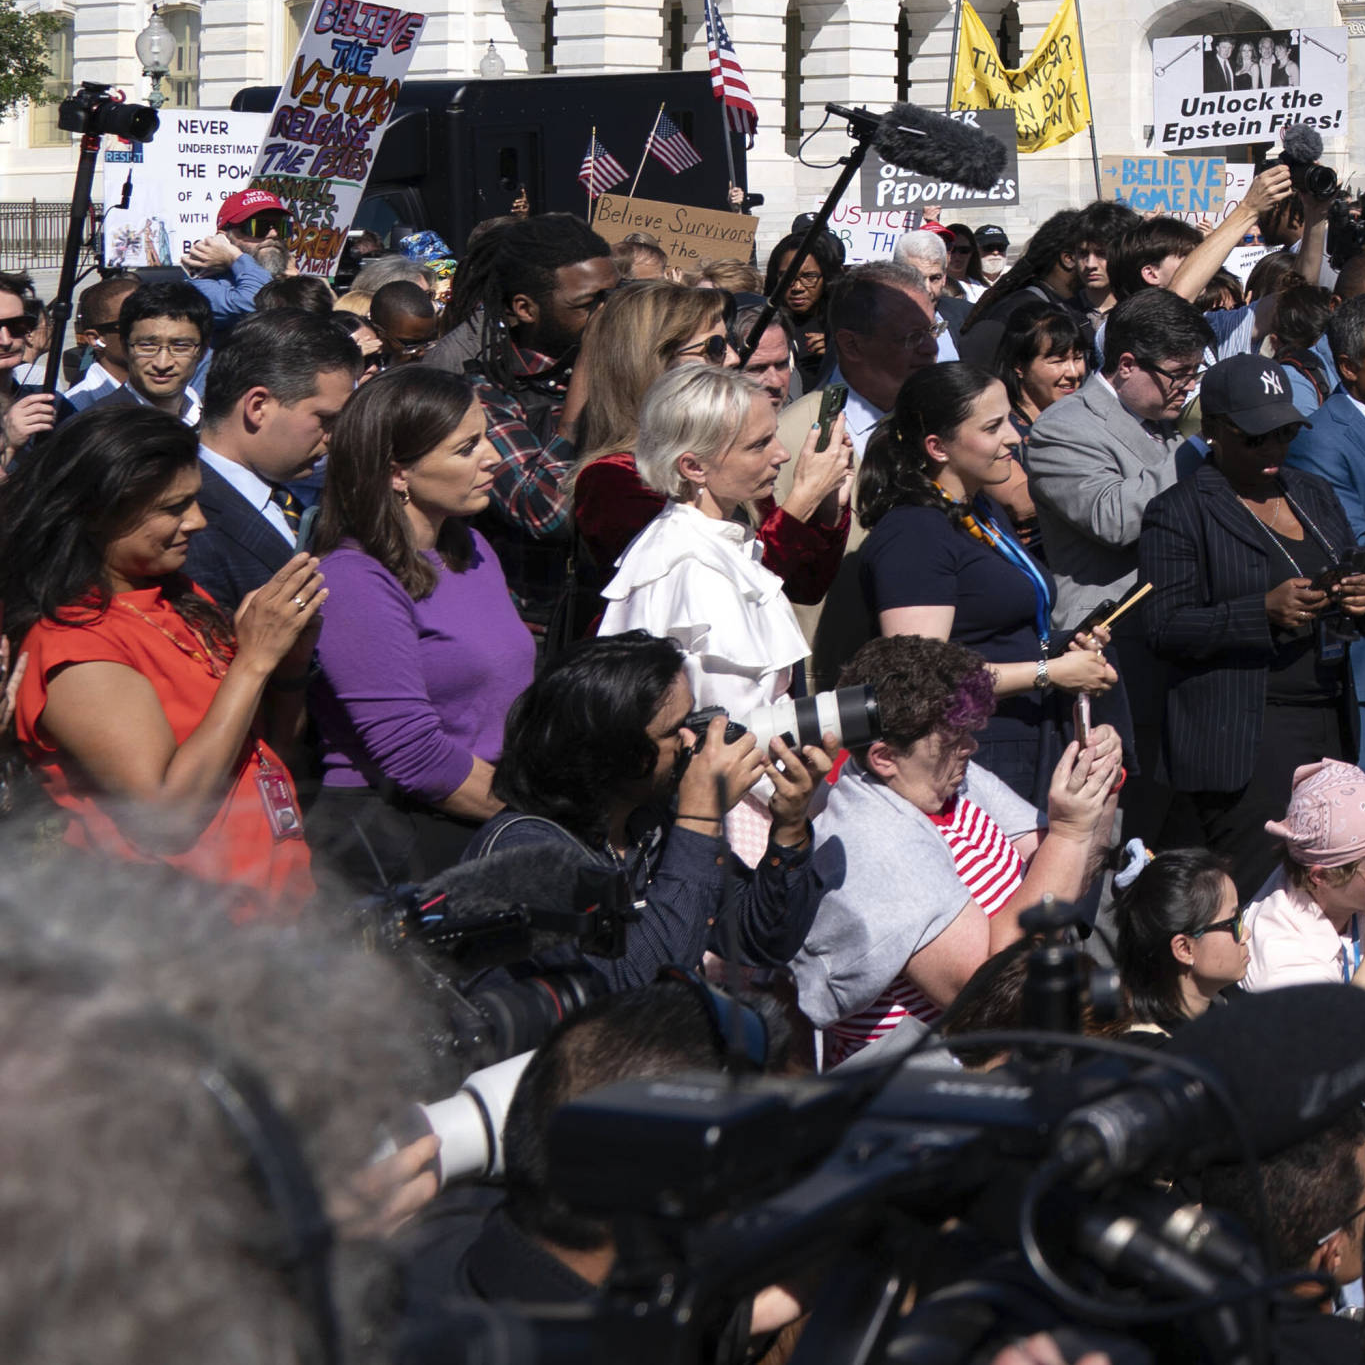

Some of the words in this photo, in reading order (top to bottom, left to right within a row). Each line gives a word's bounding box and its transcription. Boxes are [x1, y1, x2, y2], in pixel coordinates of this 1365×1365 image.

[332, 39, 378, 73] THE
[1180, 92, 1275, 117] Unlock
[1281, 90, 1323, 109] the
[178, 120, 229, 134] NEVER
[270, 105, 376, 150] RELEASE
[1162, 117, 1261, 146] Epstein
[1269, 110, 1342, 133] Files!
[178, 144, 259, 155] UNDERESTIMAT
[178, 164, 207, 178] THE
[218, 164, 252, 179] POW
[261, 143, 314, 174] THE
[309, 145, 373, 181] FILES
[1122, 158, 1225, 187] BELIEVE
[178, 191, 193, 201] OF
[206, 192, 213, 201] A
[1115, 187, 1210, 212] WOMEN
[179, 213, 209, 223] WITH
[288, 200, 339, 230] APES
[598, 197, 663, 229] Believe
[669, 208, 754, 244] Survivors
[832, 205, 919, 228] USTICE
[670, 239, 699, 259] the
[868, 231, 896, 252] TH
[1260, 370, 1284, 394] NY
